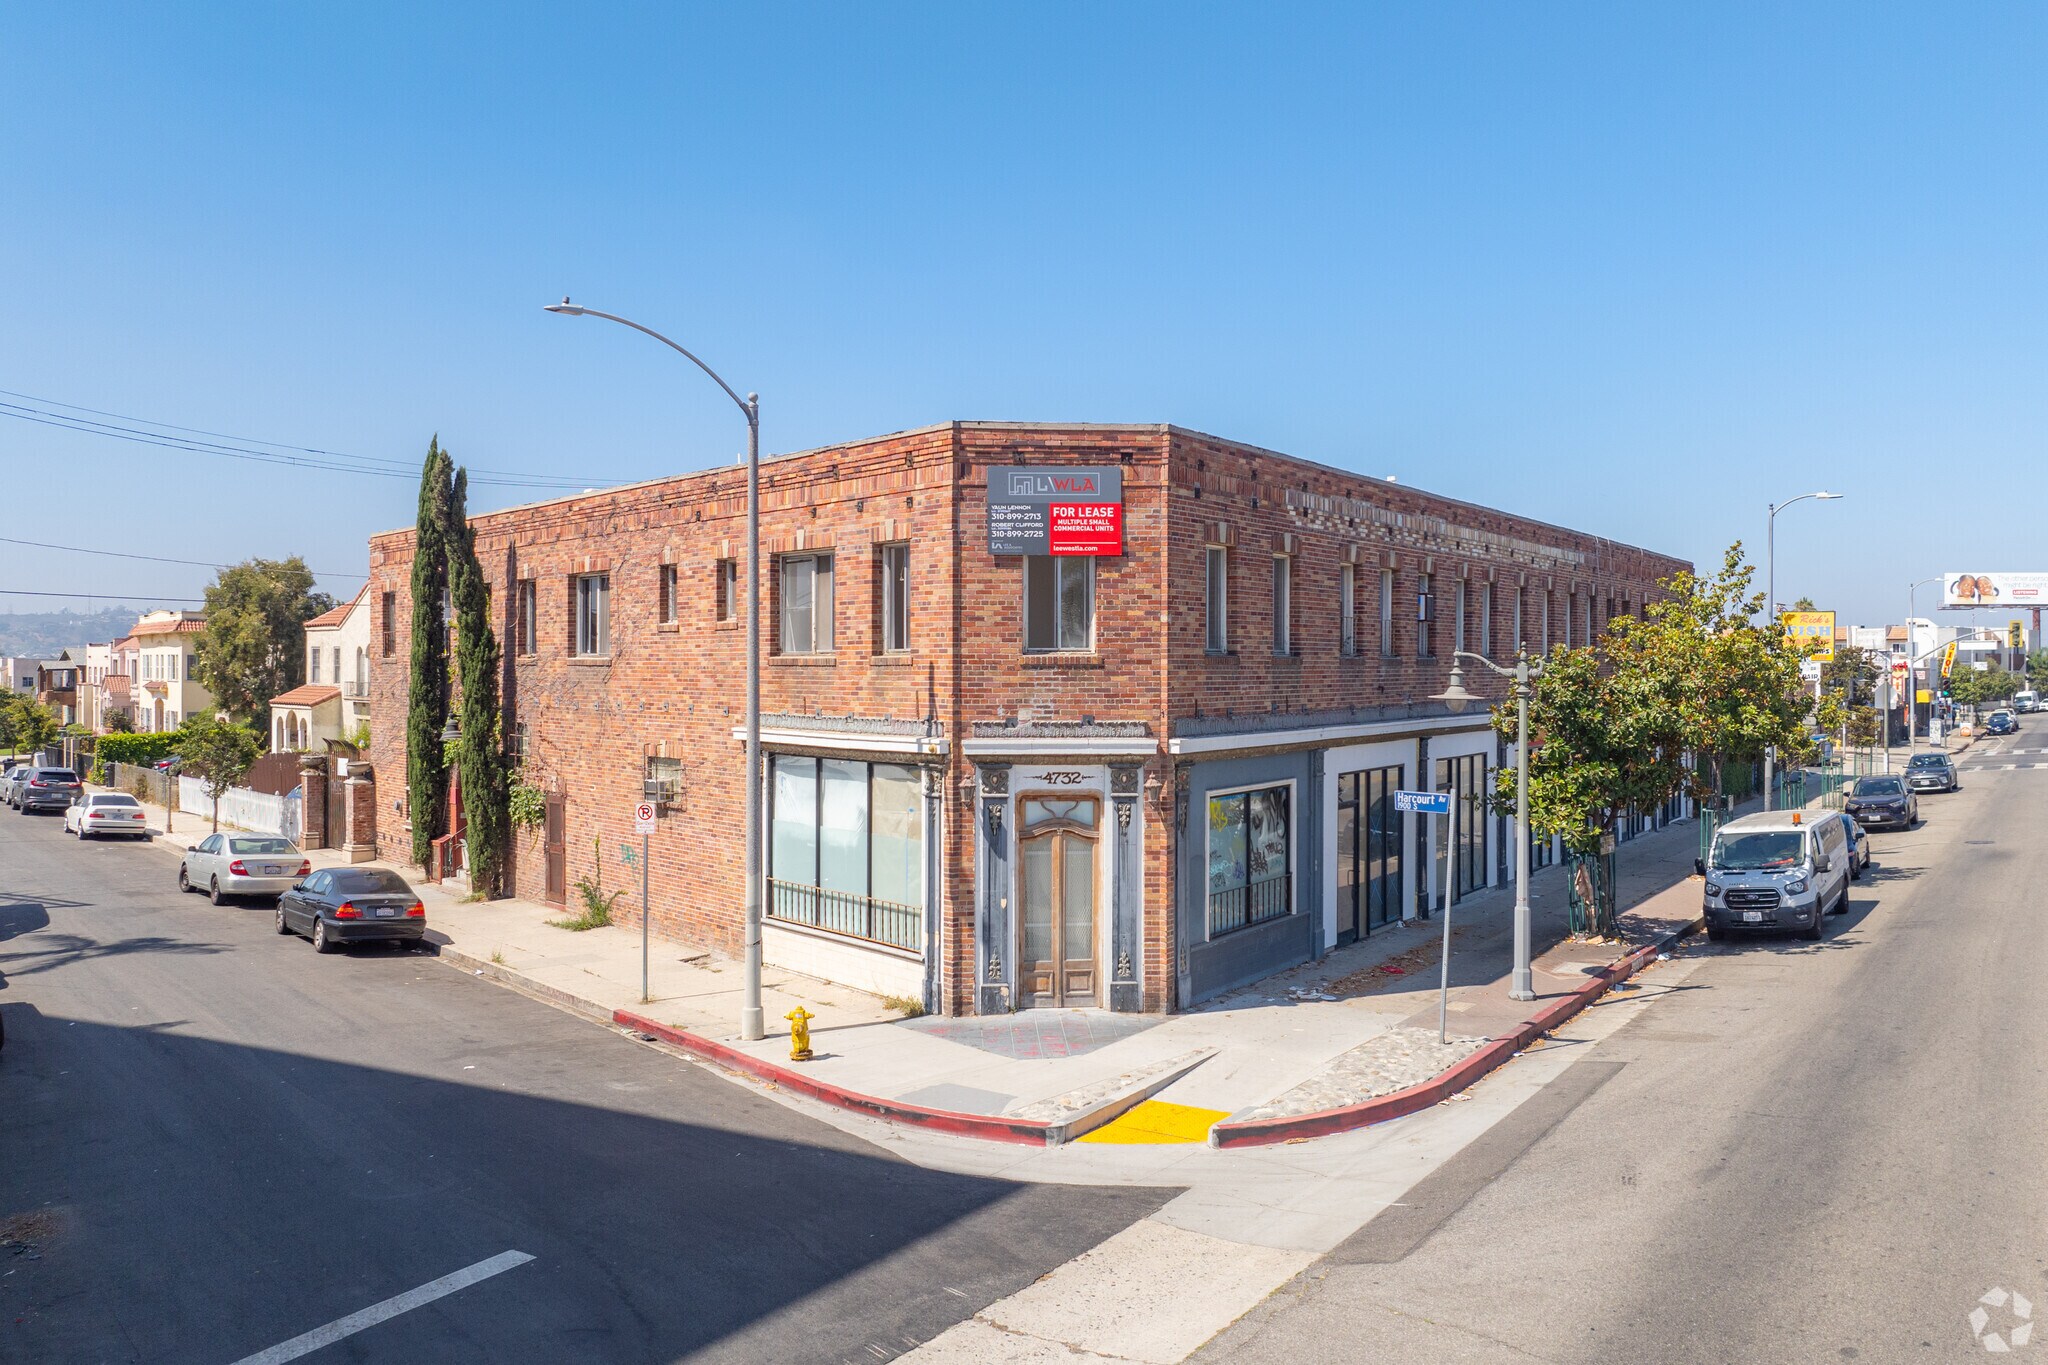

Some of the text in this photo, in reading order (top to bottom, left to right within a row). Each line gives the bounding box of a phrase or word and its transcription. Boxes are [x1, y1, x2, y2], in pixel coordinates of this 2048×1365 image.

[1053, 507, 1114, 517] FOR LEASE
[1800, 614, 1830, 624] Rick's
[1786, 626, 1831, 636] FISH
[1042, 772, 1082, 784] 4732
[1397, 793, 1435, 805] Harcourt
